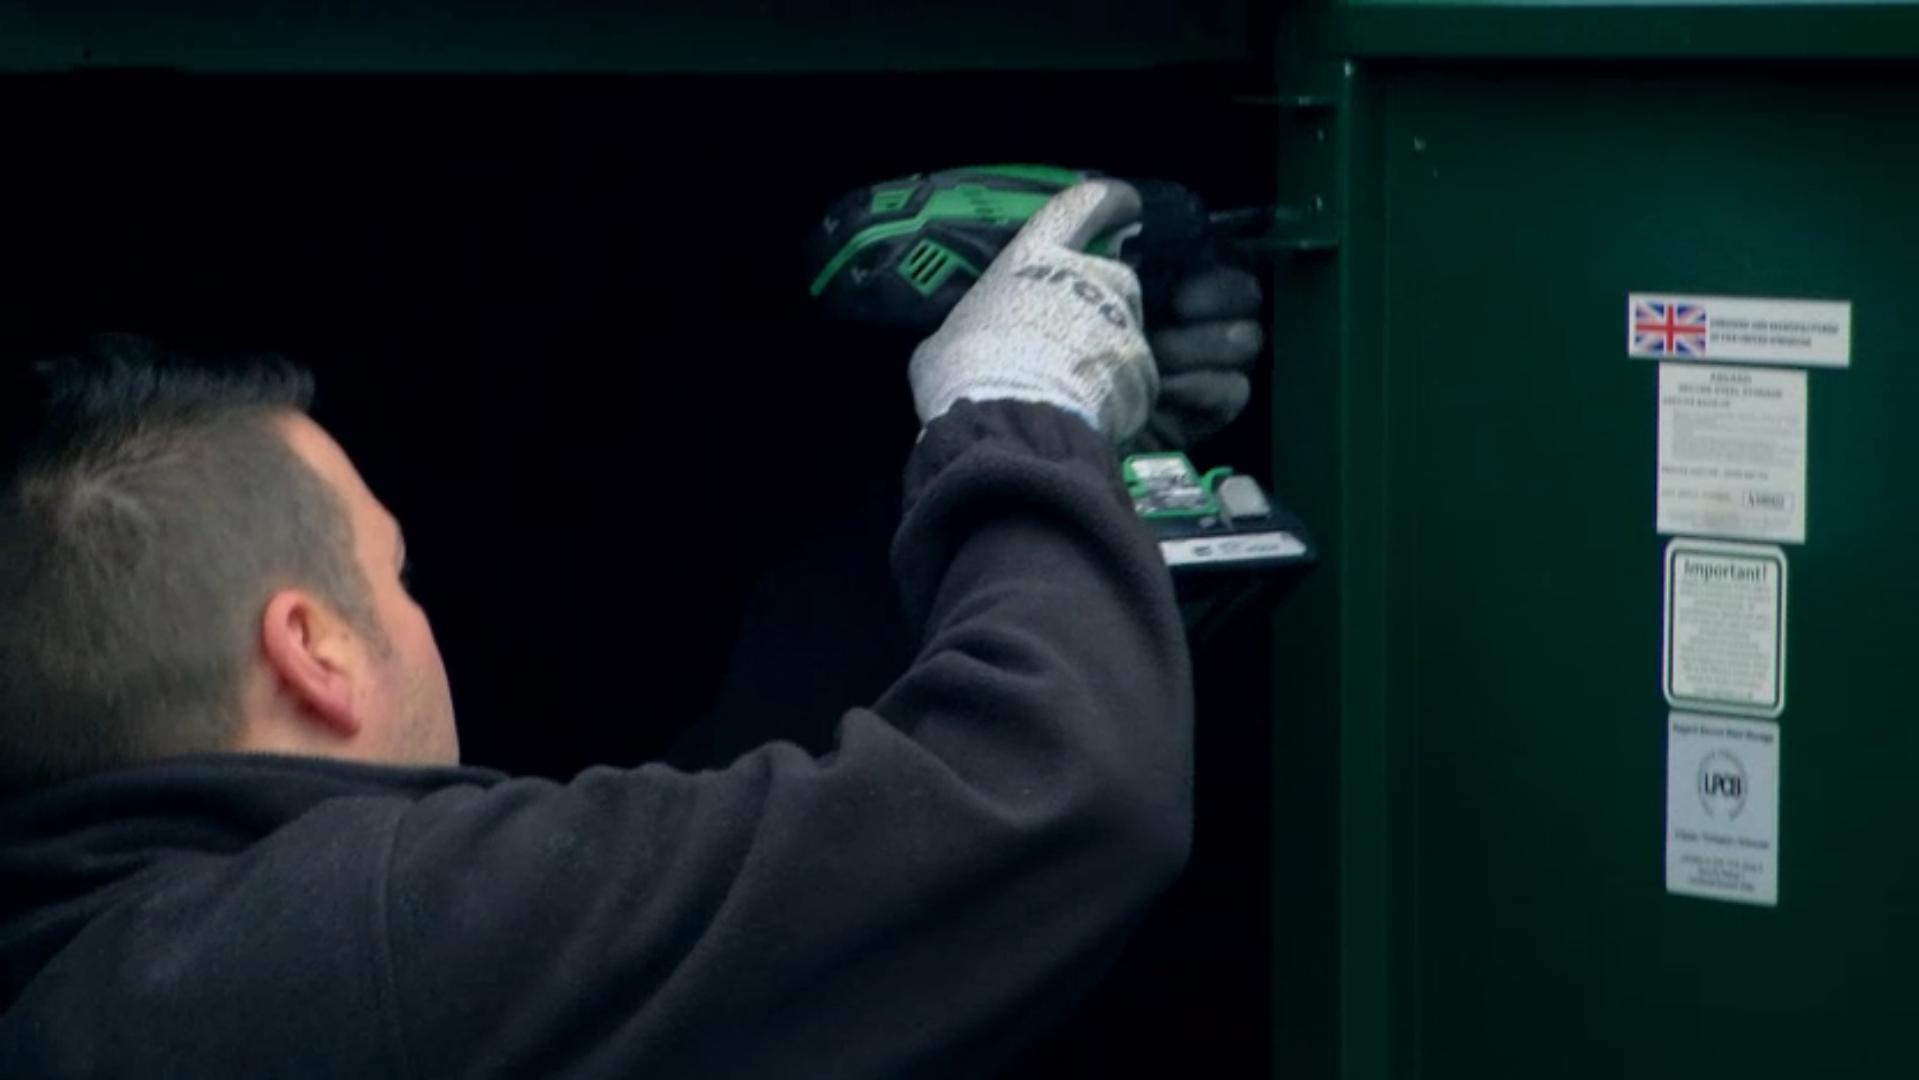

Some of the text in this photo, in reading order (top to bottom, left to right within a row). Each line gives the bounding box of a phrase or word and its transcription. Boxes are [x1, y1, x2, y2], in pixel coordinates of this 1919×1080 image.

[1014, 264, 1127, 329] arco
[1684, 557, 1766, 583] Important!
[1703, 770, 1742, 800] LPCB
